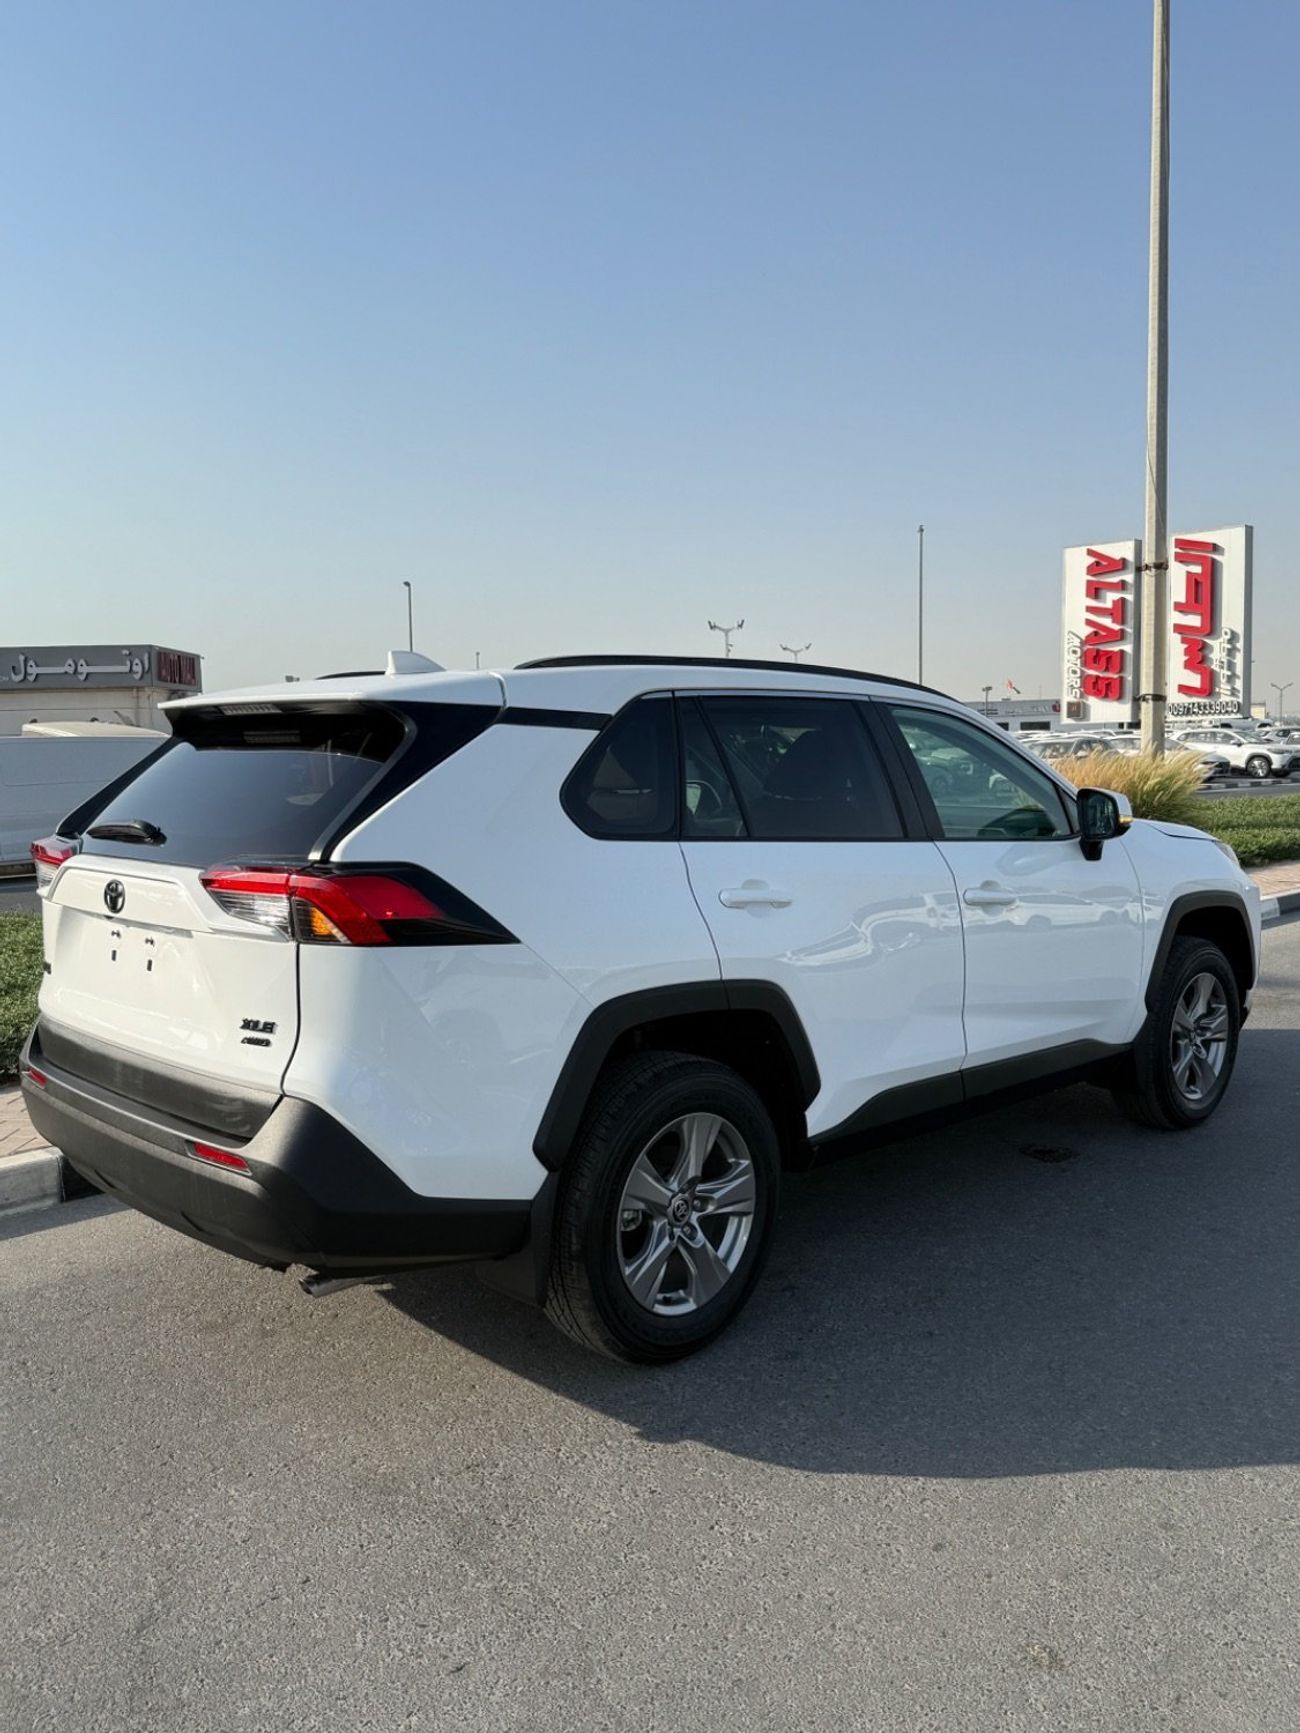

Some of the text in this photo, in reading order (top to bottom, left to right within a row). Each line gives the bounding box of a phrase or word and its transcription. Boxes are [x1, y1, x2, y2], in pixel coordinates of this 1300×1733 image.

[1066, 630, 1083, 699] MOTORS
[1082, 548, 1126, 701] ALTASS
[1173, 537, 1216, 698] الطاس
[239, 1018, 276, 1034] XLE
